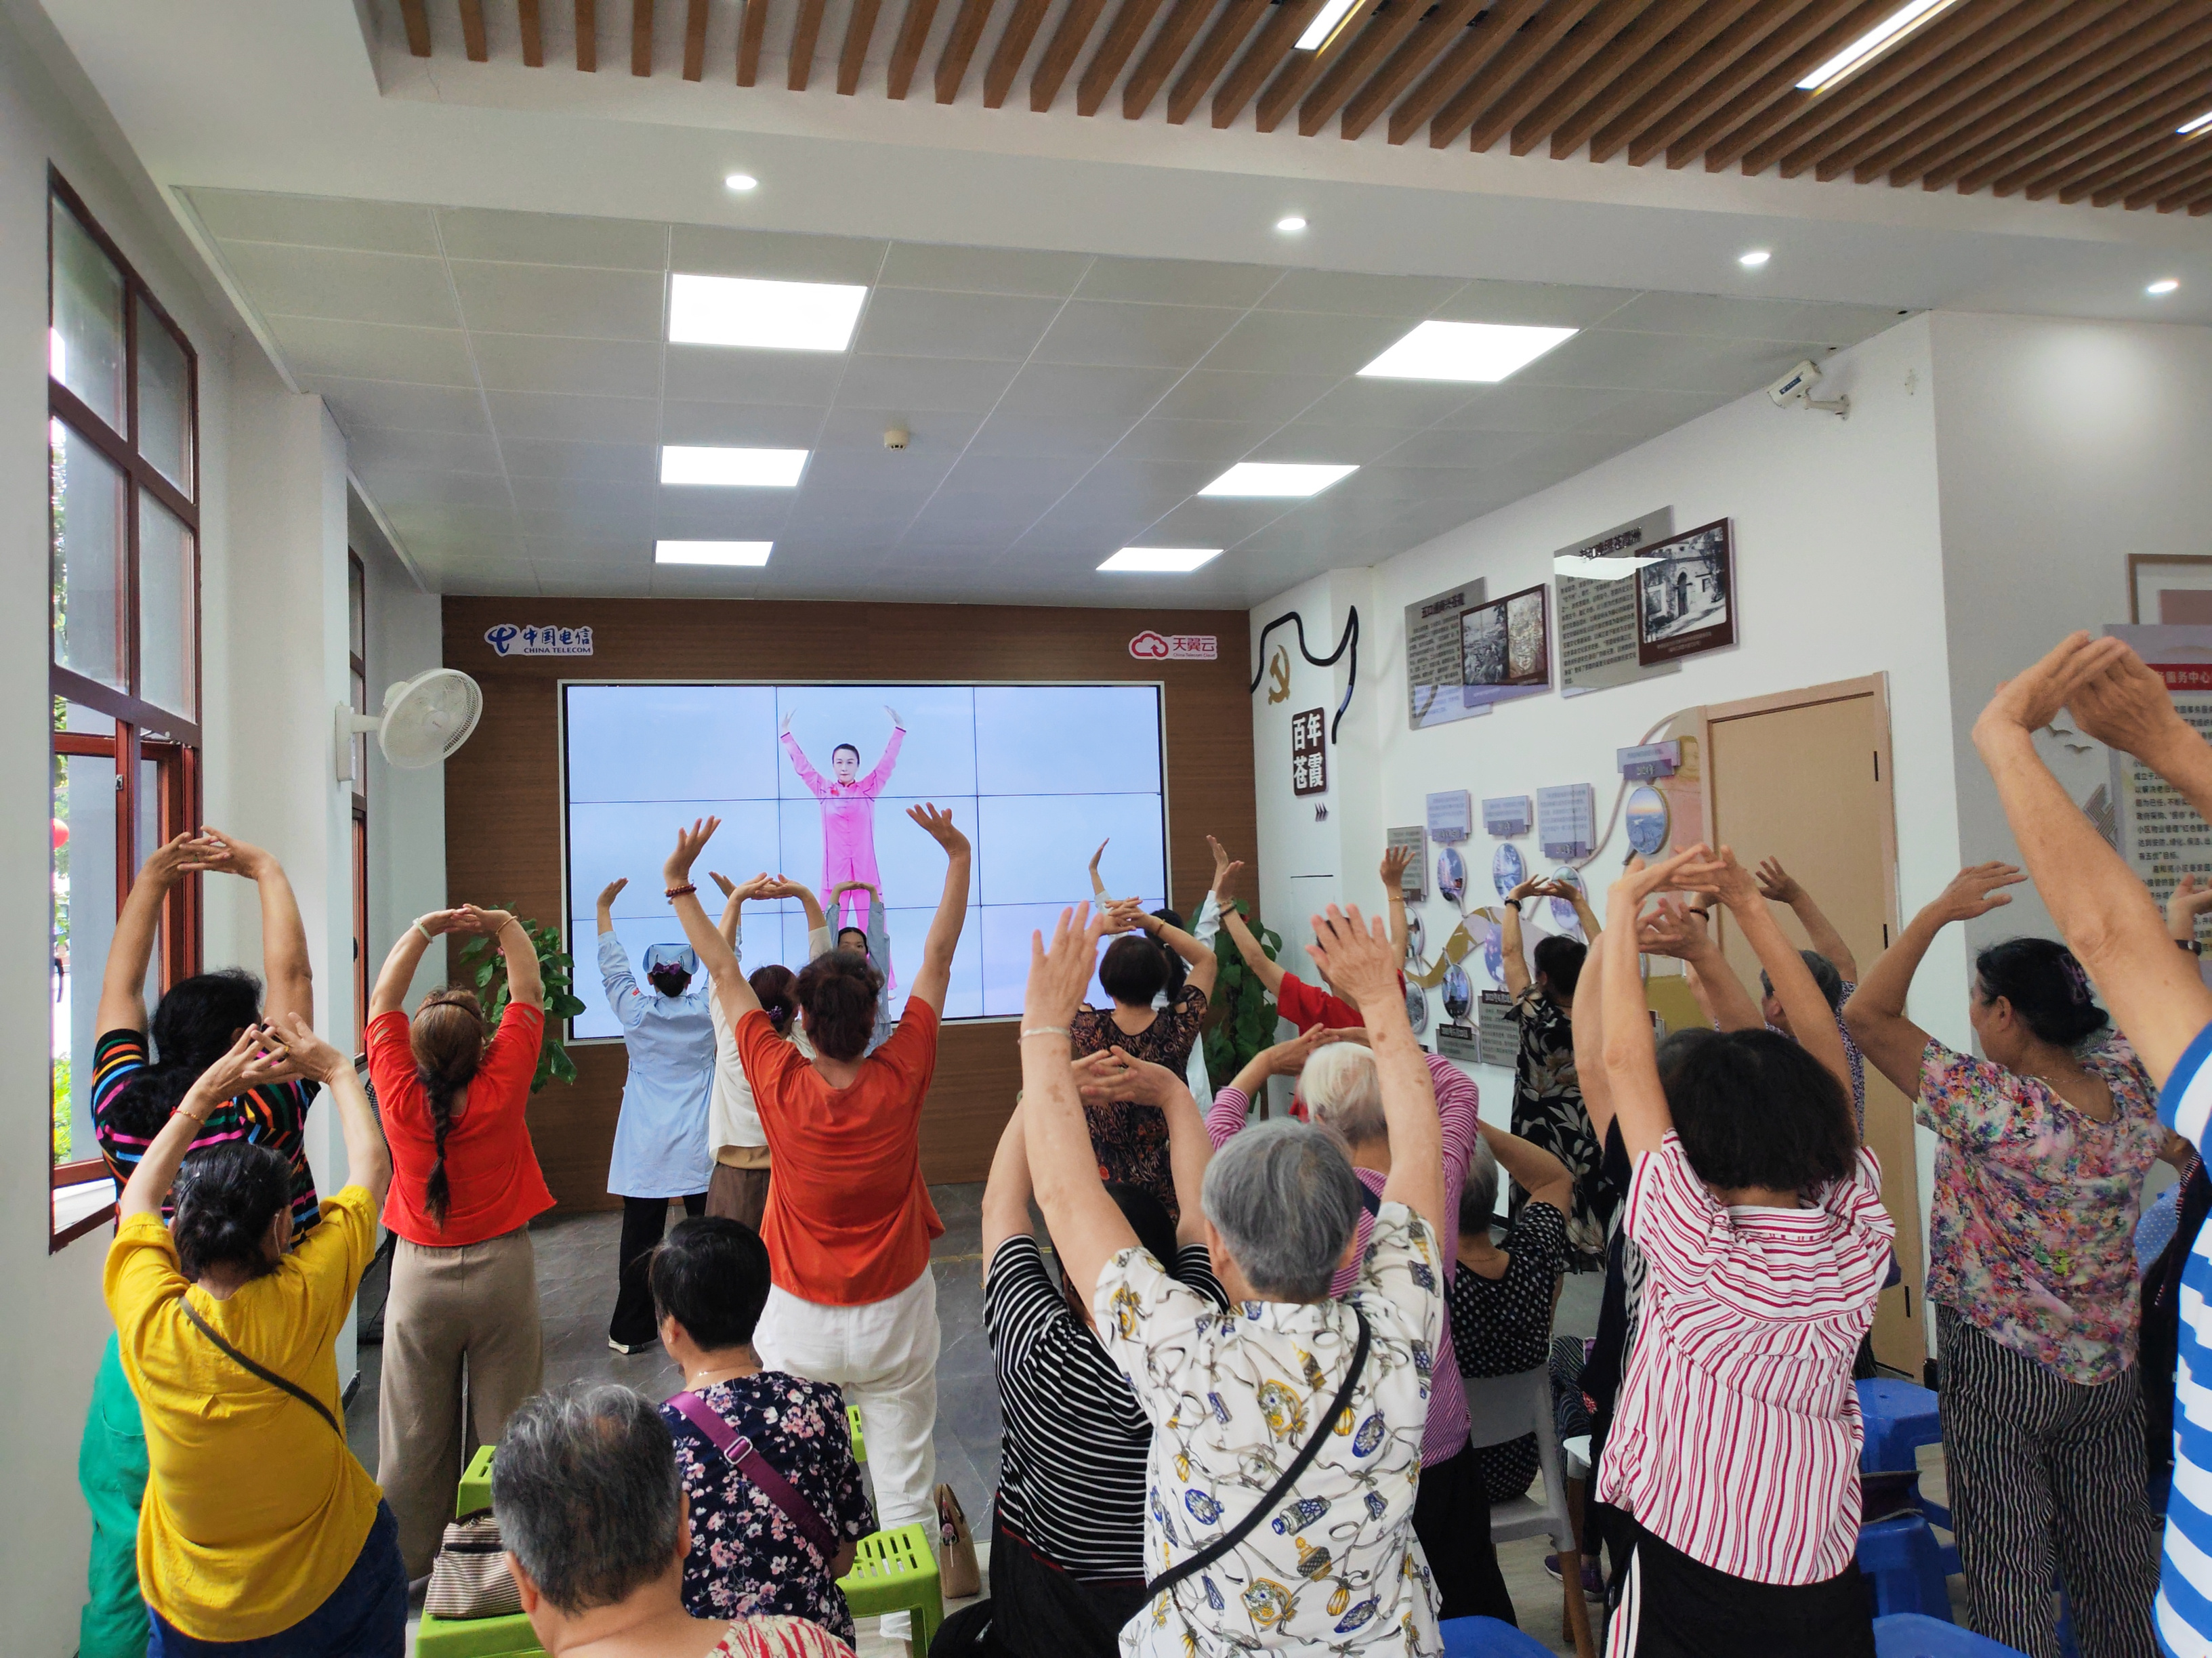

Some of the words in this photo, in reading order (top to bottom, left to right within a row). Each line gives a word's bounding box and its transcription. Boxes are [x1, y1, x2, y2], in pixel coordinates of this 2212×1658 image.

[523, 627, 590, 647] 中国电信
[1173, 637, 1214, 651] 天翼云
[1293, 713, 1322, 751] 百年
[1293, 752, 1324, 790] 苍霞
